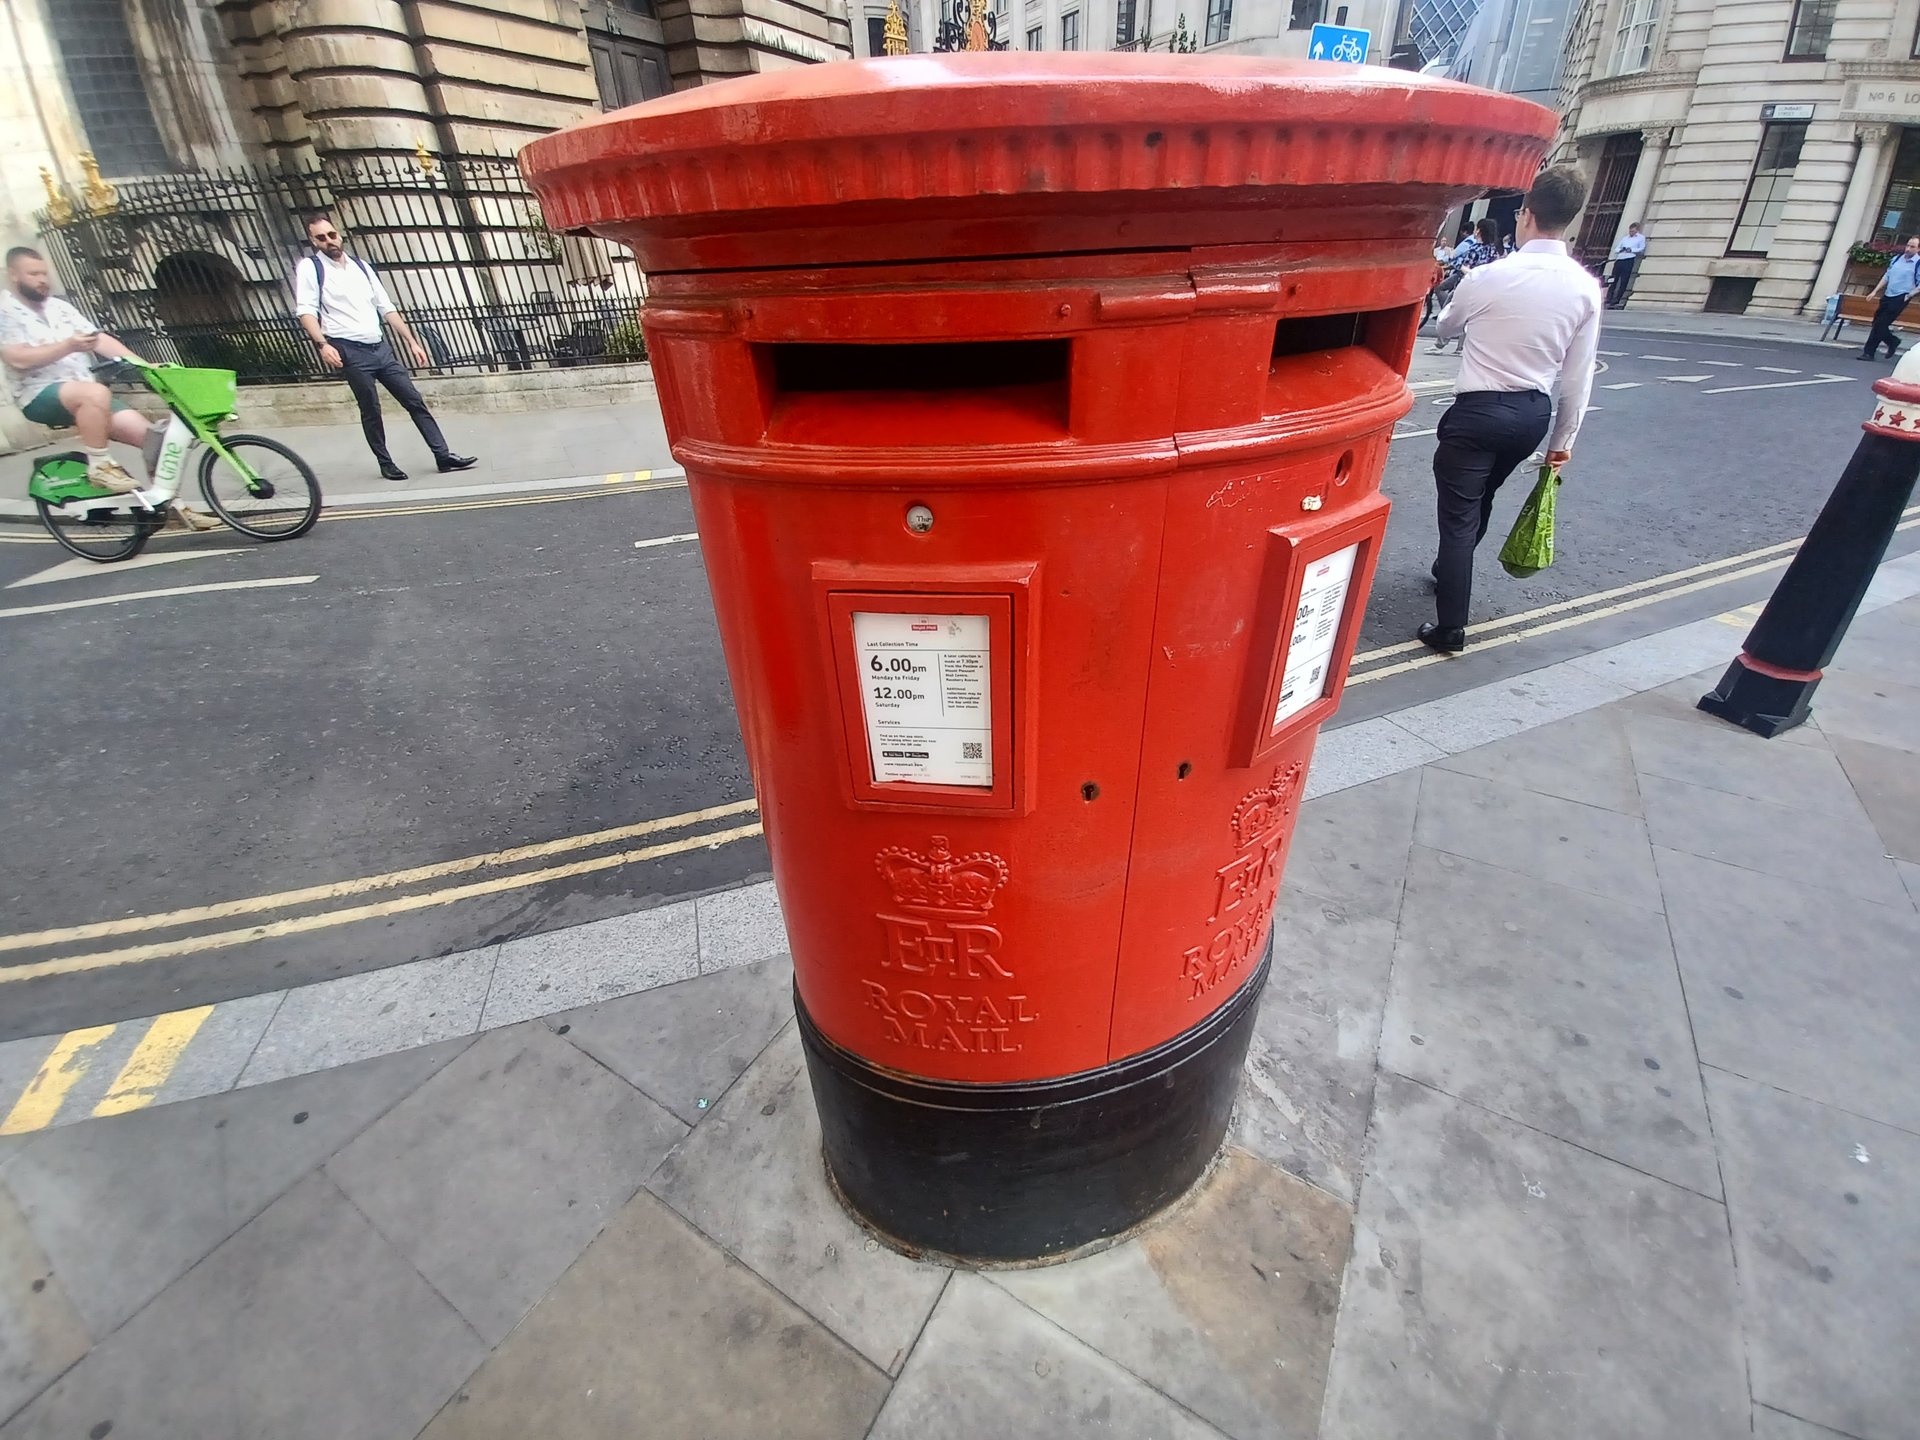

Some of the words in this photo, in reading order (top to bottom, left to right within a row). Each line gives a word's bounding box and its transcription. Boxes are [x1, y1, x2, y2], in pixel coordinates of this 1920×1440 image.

[1888, 92, 1896, 103] 6
[871, 655, 926, 673] 6.00pm
[874, 687, 924, 700] 12.00pm
[1179, 885, 1278, 980] ROYAL
[861, 979, 1040, 1025] ROYAL
[884, 1014, 1024, 1053] MAIL
